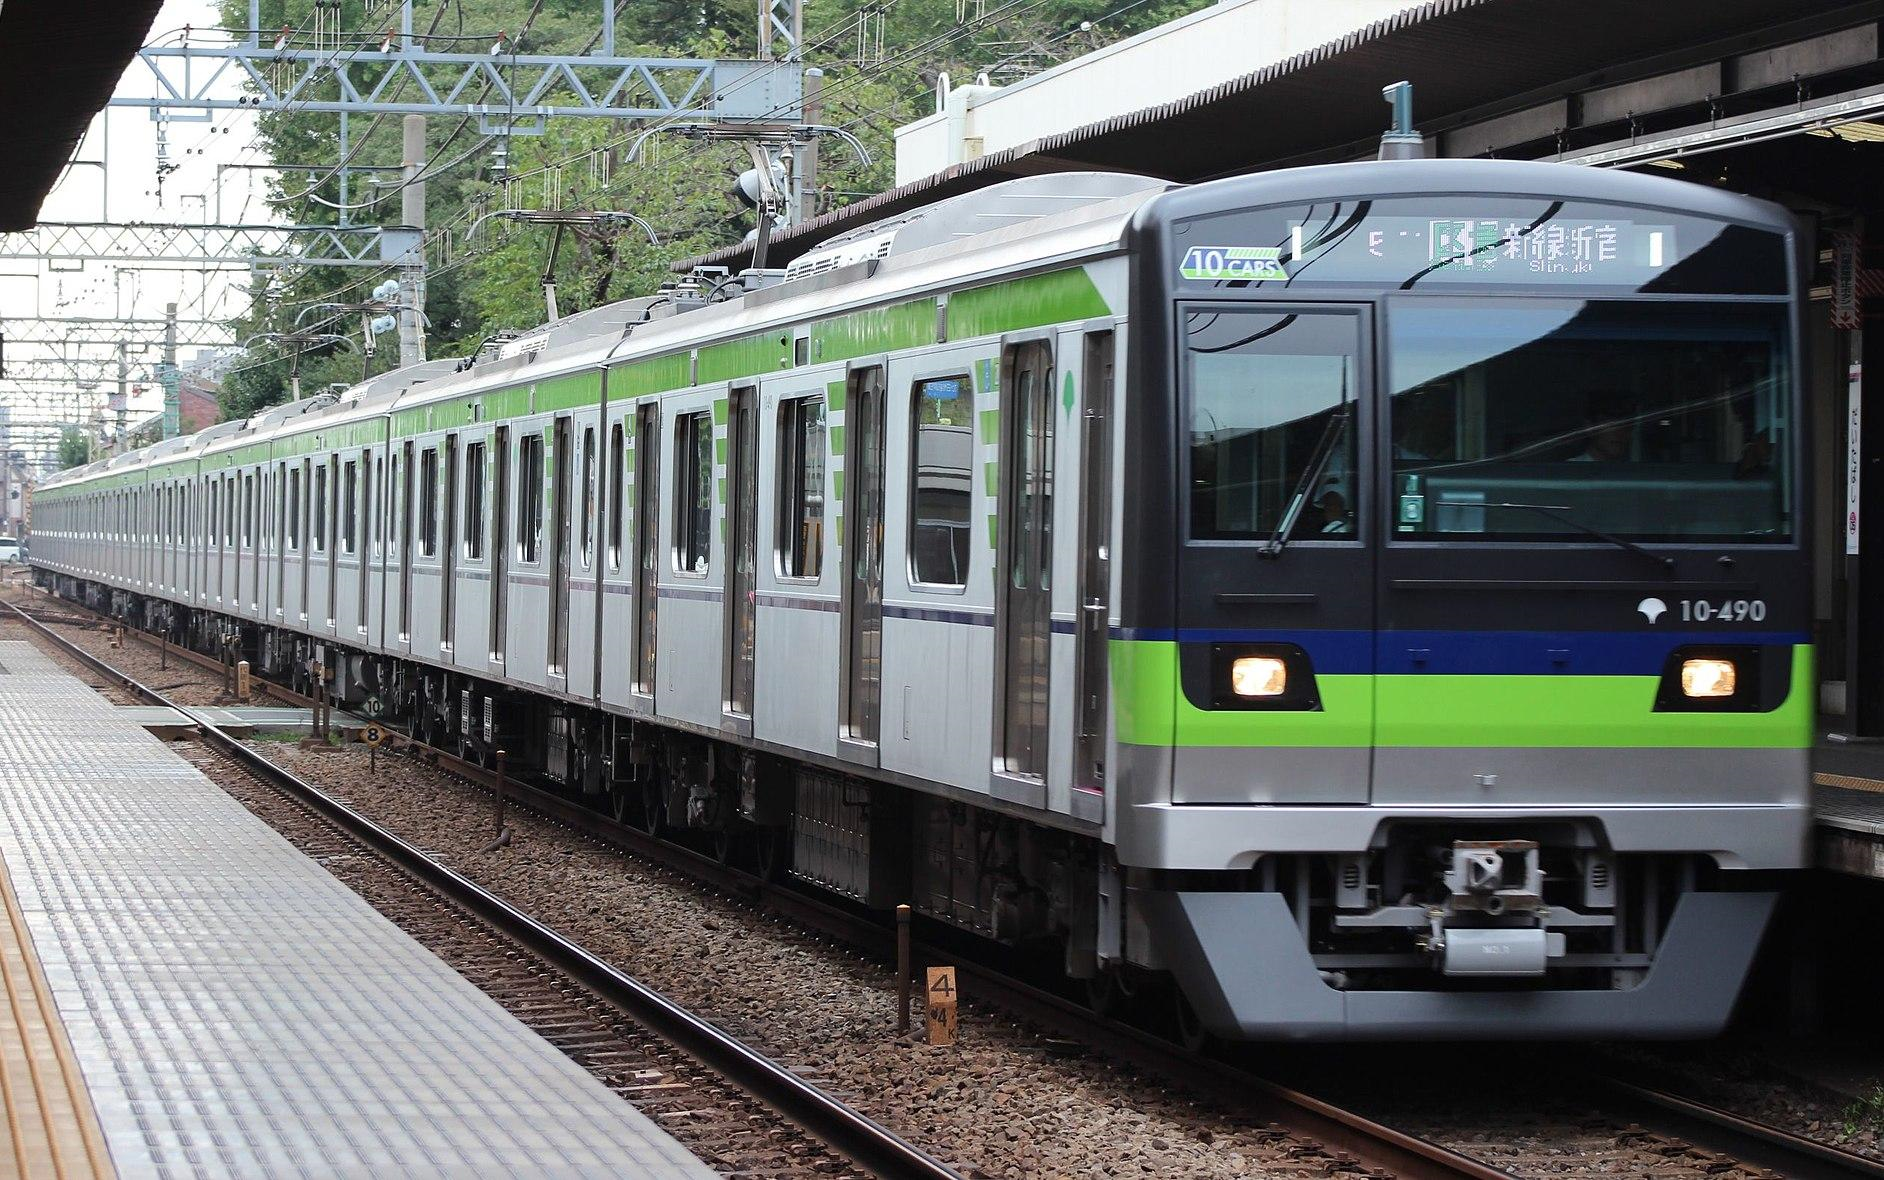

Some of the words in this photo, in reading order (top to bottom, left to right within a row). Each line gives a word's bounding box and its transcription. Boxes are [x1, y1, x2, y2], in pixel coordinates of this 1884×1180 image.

[1191, 250, 1224, 277] 10
[1227, 260, 1276, 277] CARS
[1680, 600, 1767, 622] 10-490
[367, 701, 380, 713] 10
[367, 728, 379, 741] 8
[929, 974, 955, 997] 4
